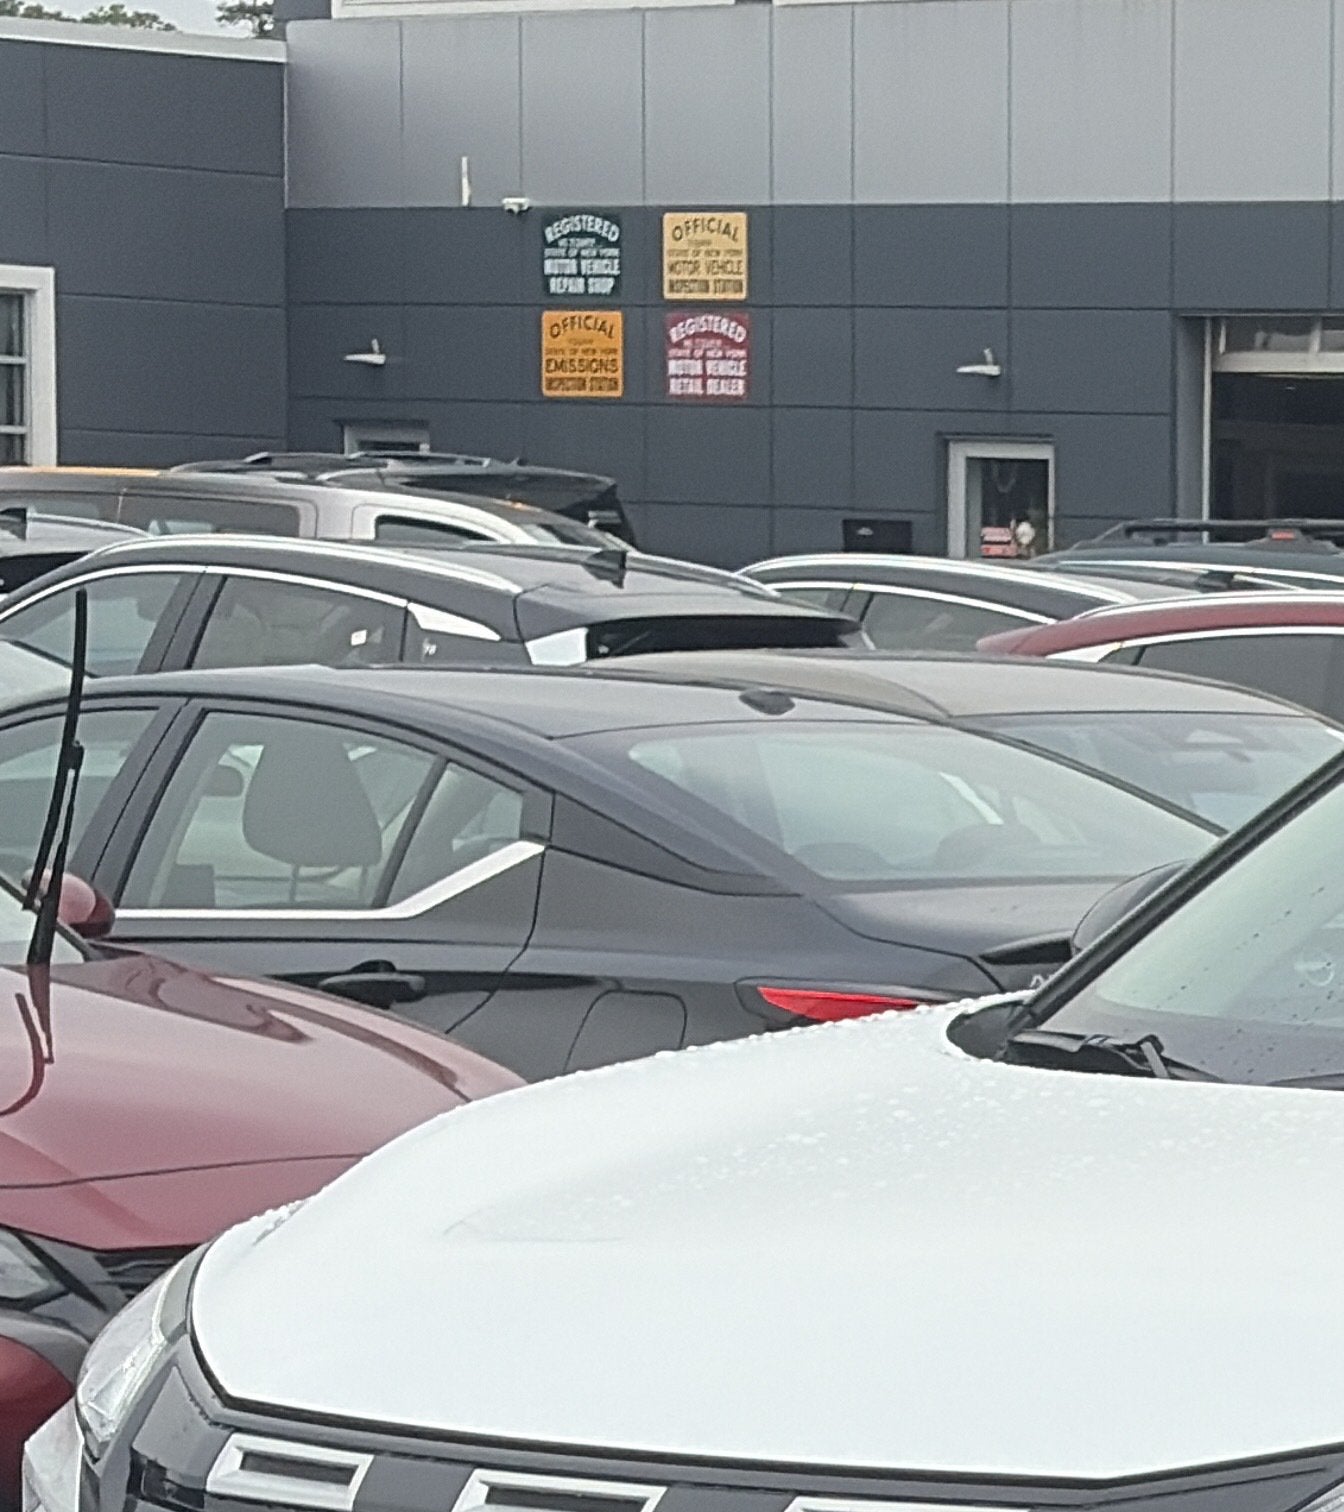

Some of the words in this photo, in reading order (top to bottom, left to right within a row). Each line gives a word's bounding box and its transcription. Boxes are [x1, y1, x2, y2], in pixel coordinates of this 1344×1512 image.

[544, 214, 620, 244] REGISTERED
[671, 217, 739, 242] OFFICIAL
[580, 259, 620, 275] VEHICLE
[668, 260, 700, 275] MOTOR
[705, 259, 743, 275] VEHICLE
[550, 277, 585, 294] REPAIR
[587, 277, 615, 294] SHOP
[550, 315, 615, 339] OFFICIAL
[669, 315, 747, 343] REGISTERED
[545, 358, 619, 373] EMISSIONS
[706, 360, 747, 376] VEHICLE
